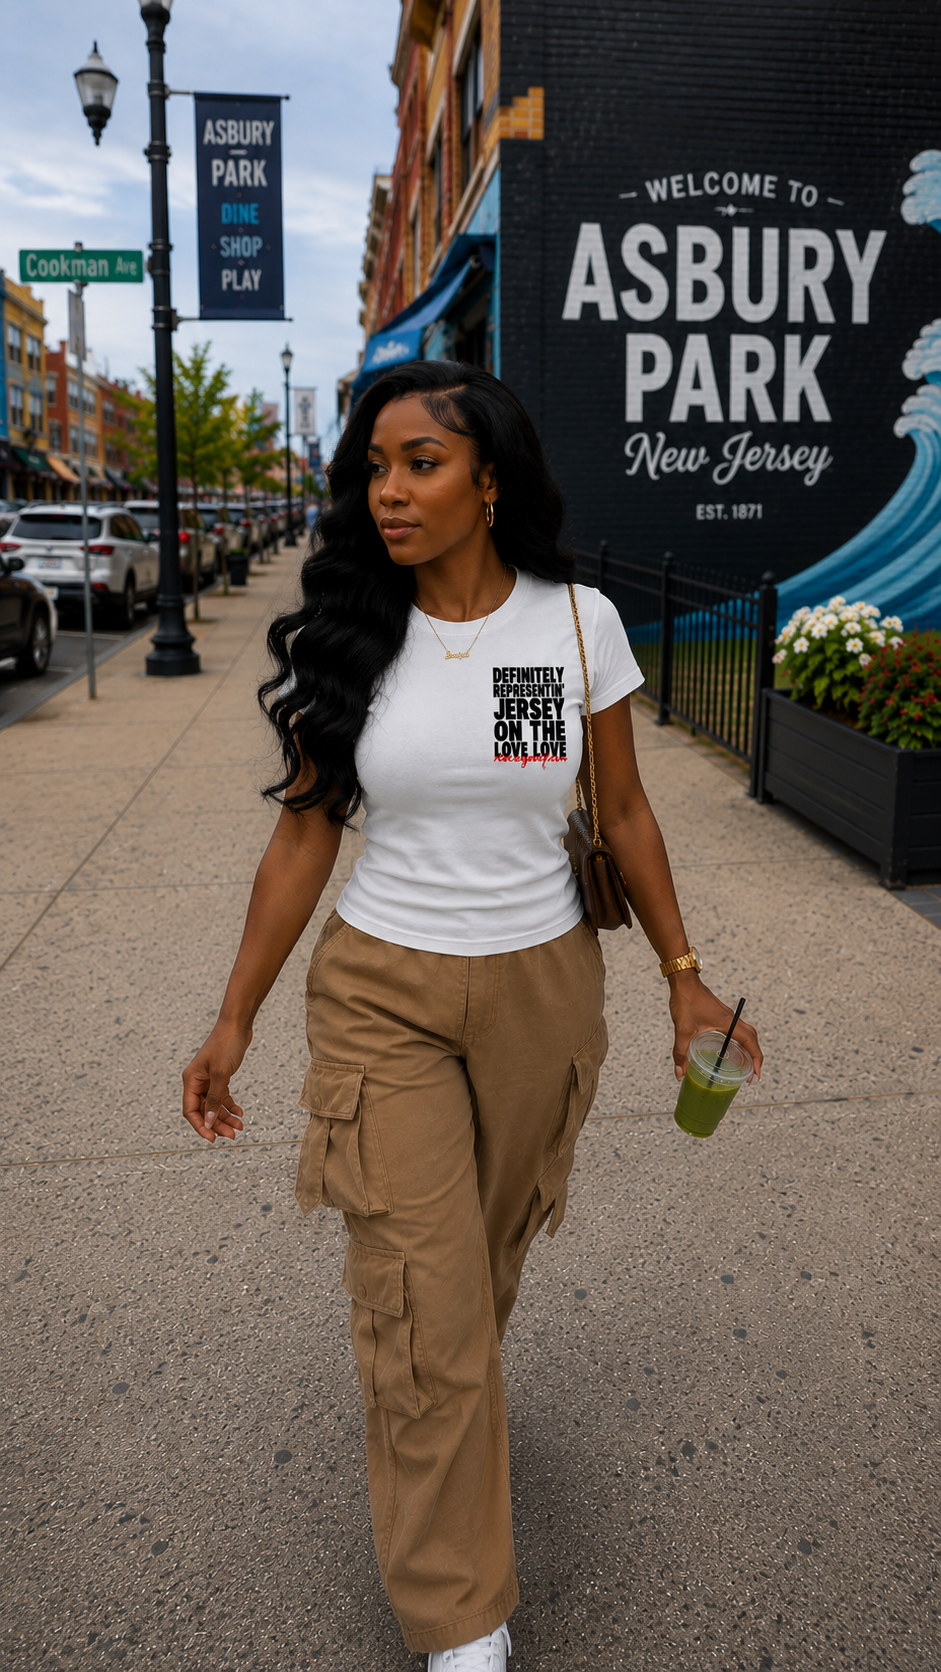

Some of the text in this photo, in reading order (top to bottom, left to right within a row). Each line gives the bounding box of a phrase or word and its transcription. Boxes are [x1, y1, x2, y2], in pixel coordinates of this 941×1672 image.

[203, 119, 275, 146] ASBURY
[211, 159, 268, 187] PARK
[645, 171, 819, 208] WELCOME TO
[221, 203, 260, 225] DINE
[220, 236, 263, 258] SHOP
[26, 253, 137, 277] Cookman Ave
[562, 222, 887, 324] ASBURY
[221, 269, 262, 291] PLAY
[625, 333, 832, 423] PARK
[624, 431, 834, 486] New Jersey
[696, 504, 763, 520] EST. 1871
[493, 667, 564, 683] DEFINITELY
[493, 683, 565, 698] REPRESENTIN'
[494, 698, 564, 720] JERSEY
[494, 720, 566, 741] ON THE
[494, 741, 567, 757] LOVE LOVE
